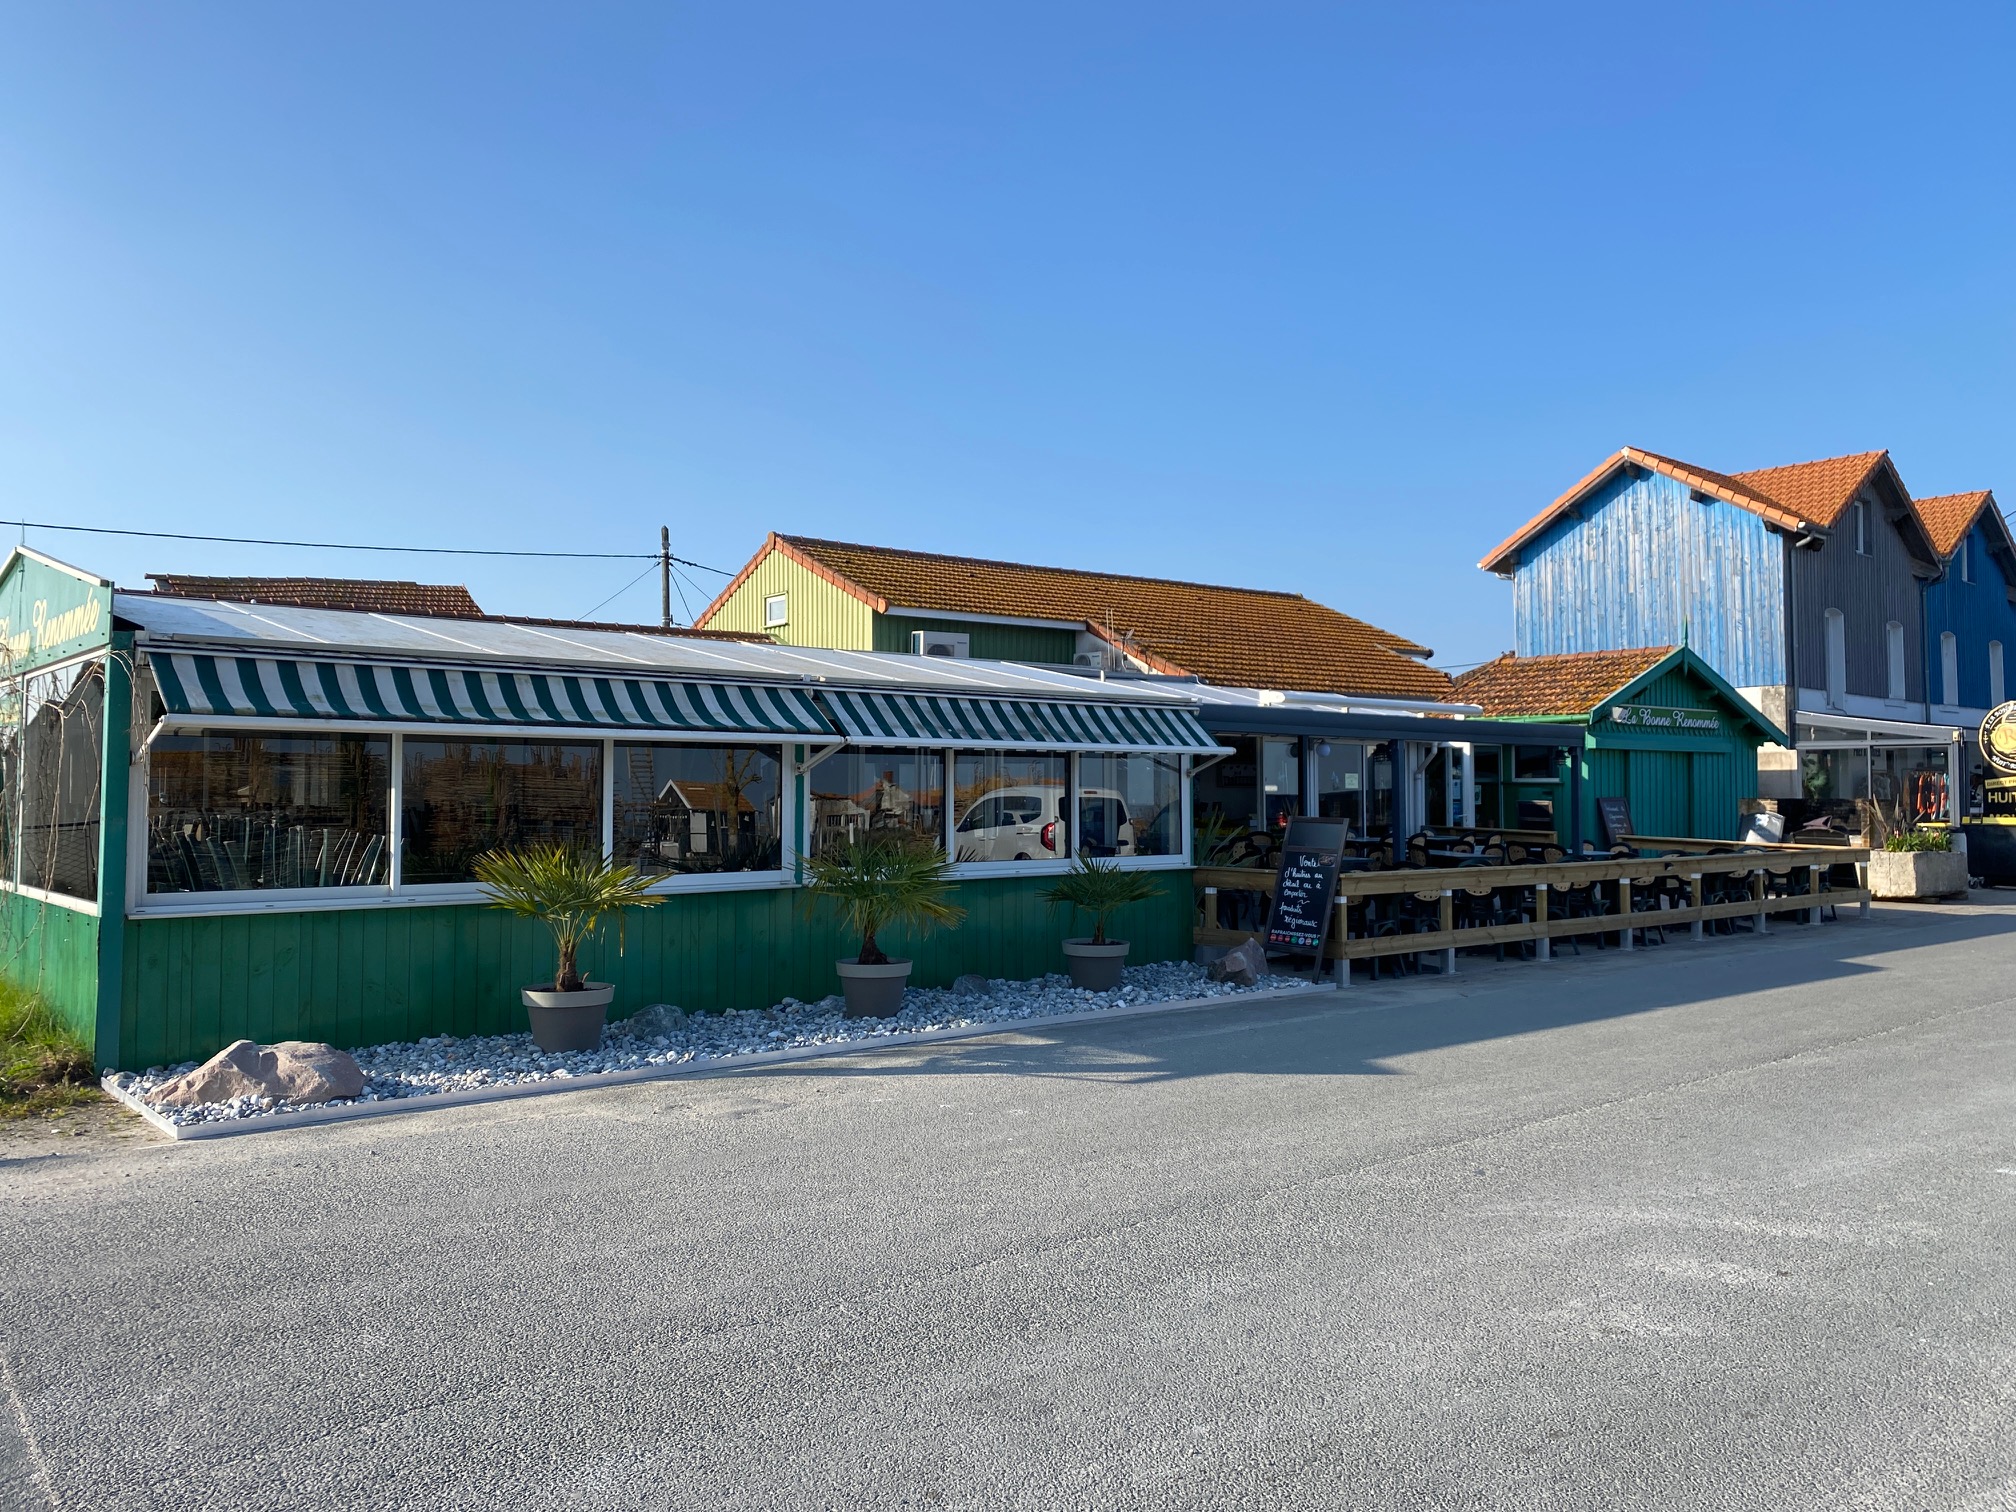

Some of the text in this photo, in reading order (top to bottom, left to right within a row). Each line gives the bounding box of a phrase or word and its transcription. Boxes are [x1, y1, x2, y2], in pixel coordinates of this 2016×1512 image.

[32, 586, 101, 653] Renommée
[1622, 707, 1720, 729] La Bonne Renommée
[1299, 854, 1319, 868] Vente
